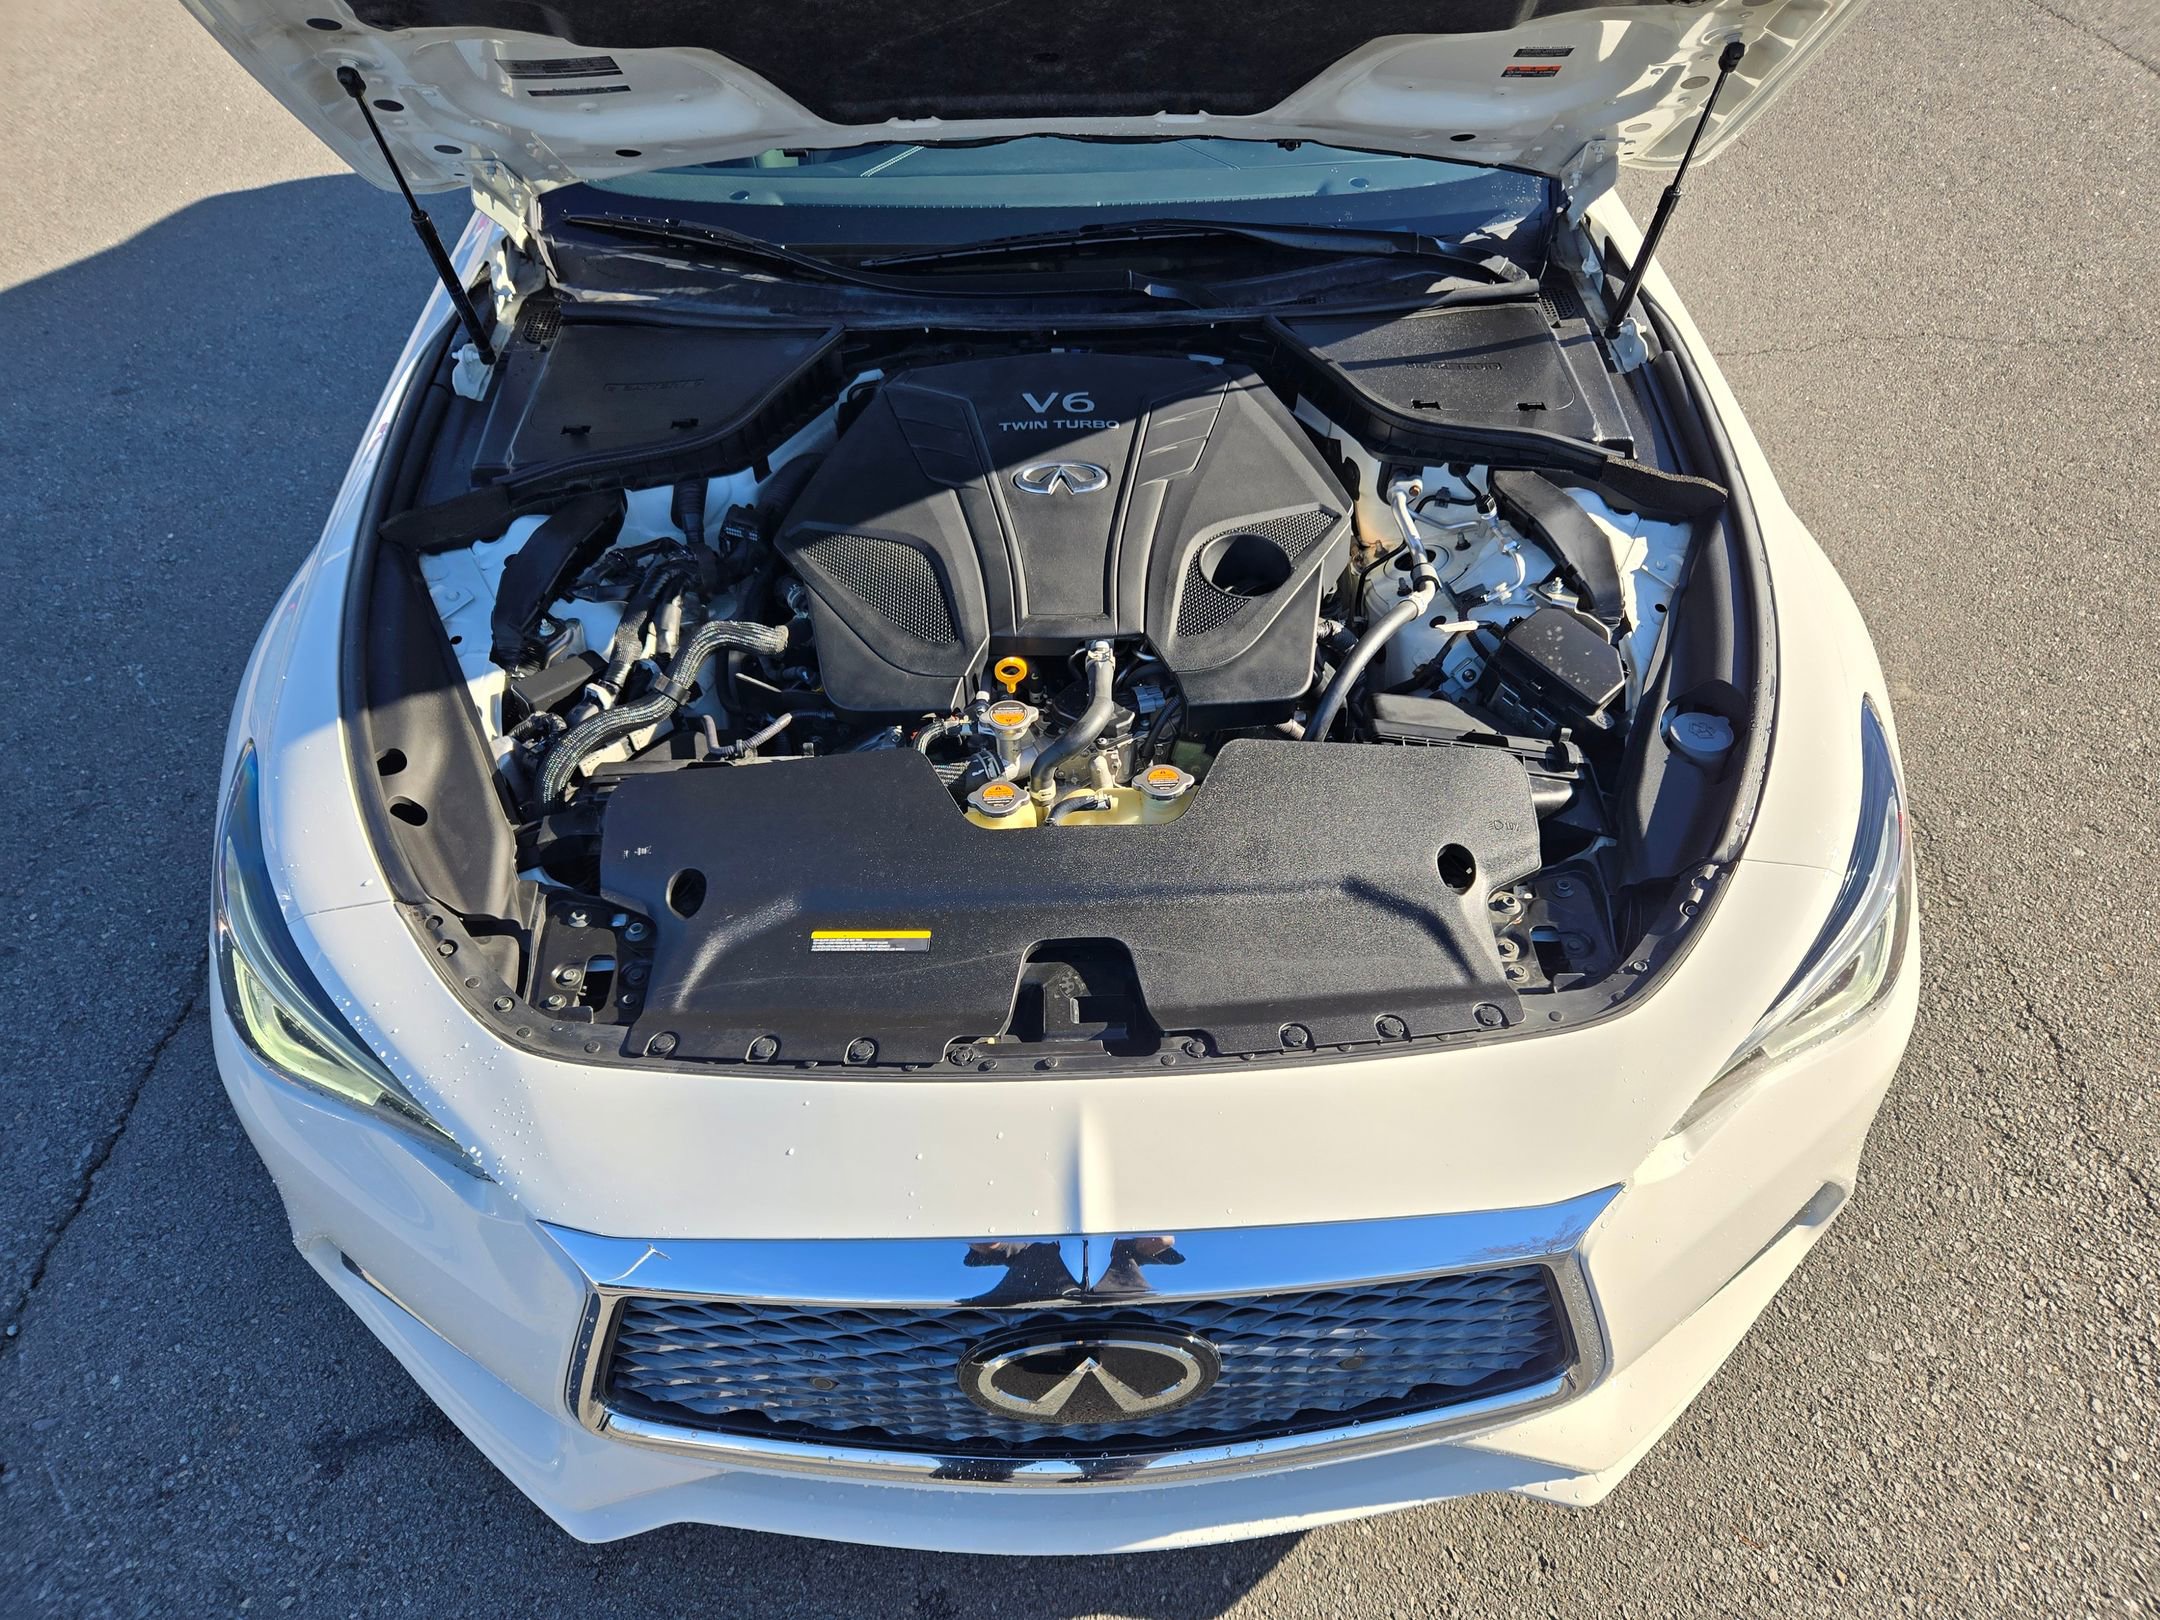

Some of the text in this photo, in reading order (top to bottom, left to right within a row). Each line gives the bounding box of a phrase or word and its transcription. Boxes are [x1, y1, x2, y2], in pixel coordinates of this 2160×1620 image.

[1022, 391, 1095, 413] V6
[999, 419, 1120, 431] TWIN TURBO
